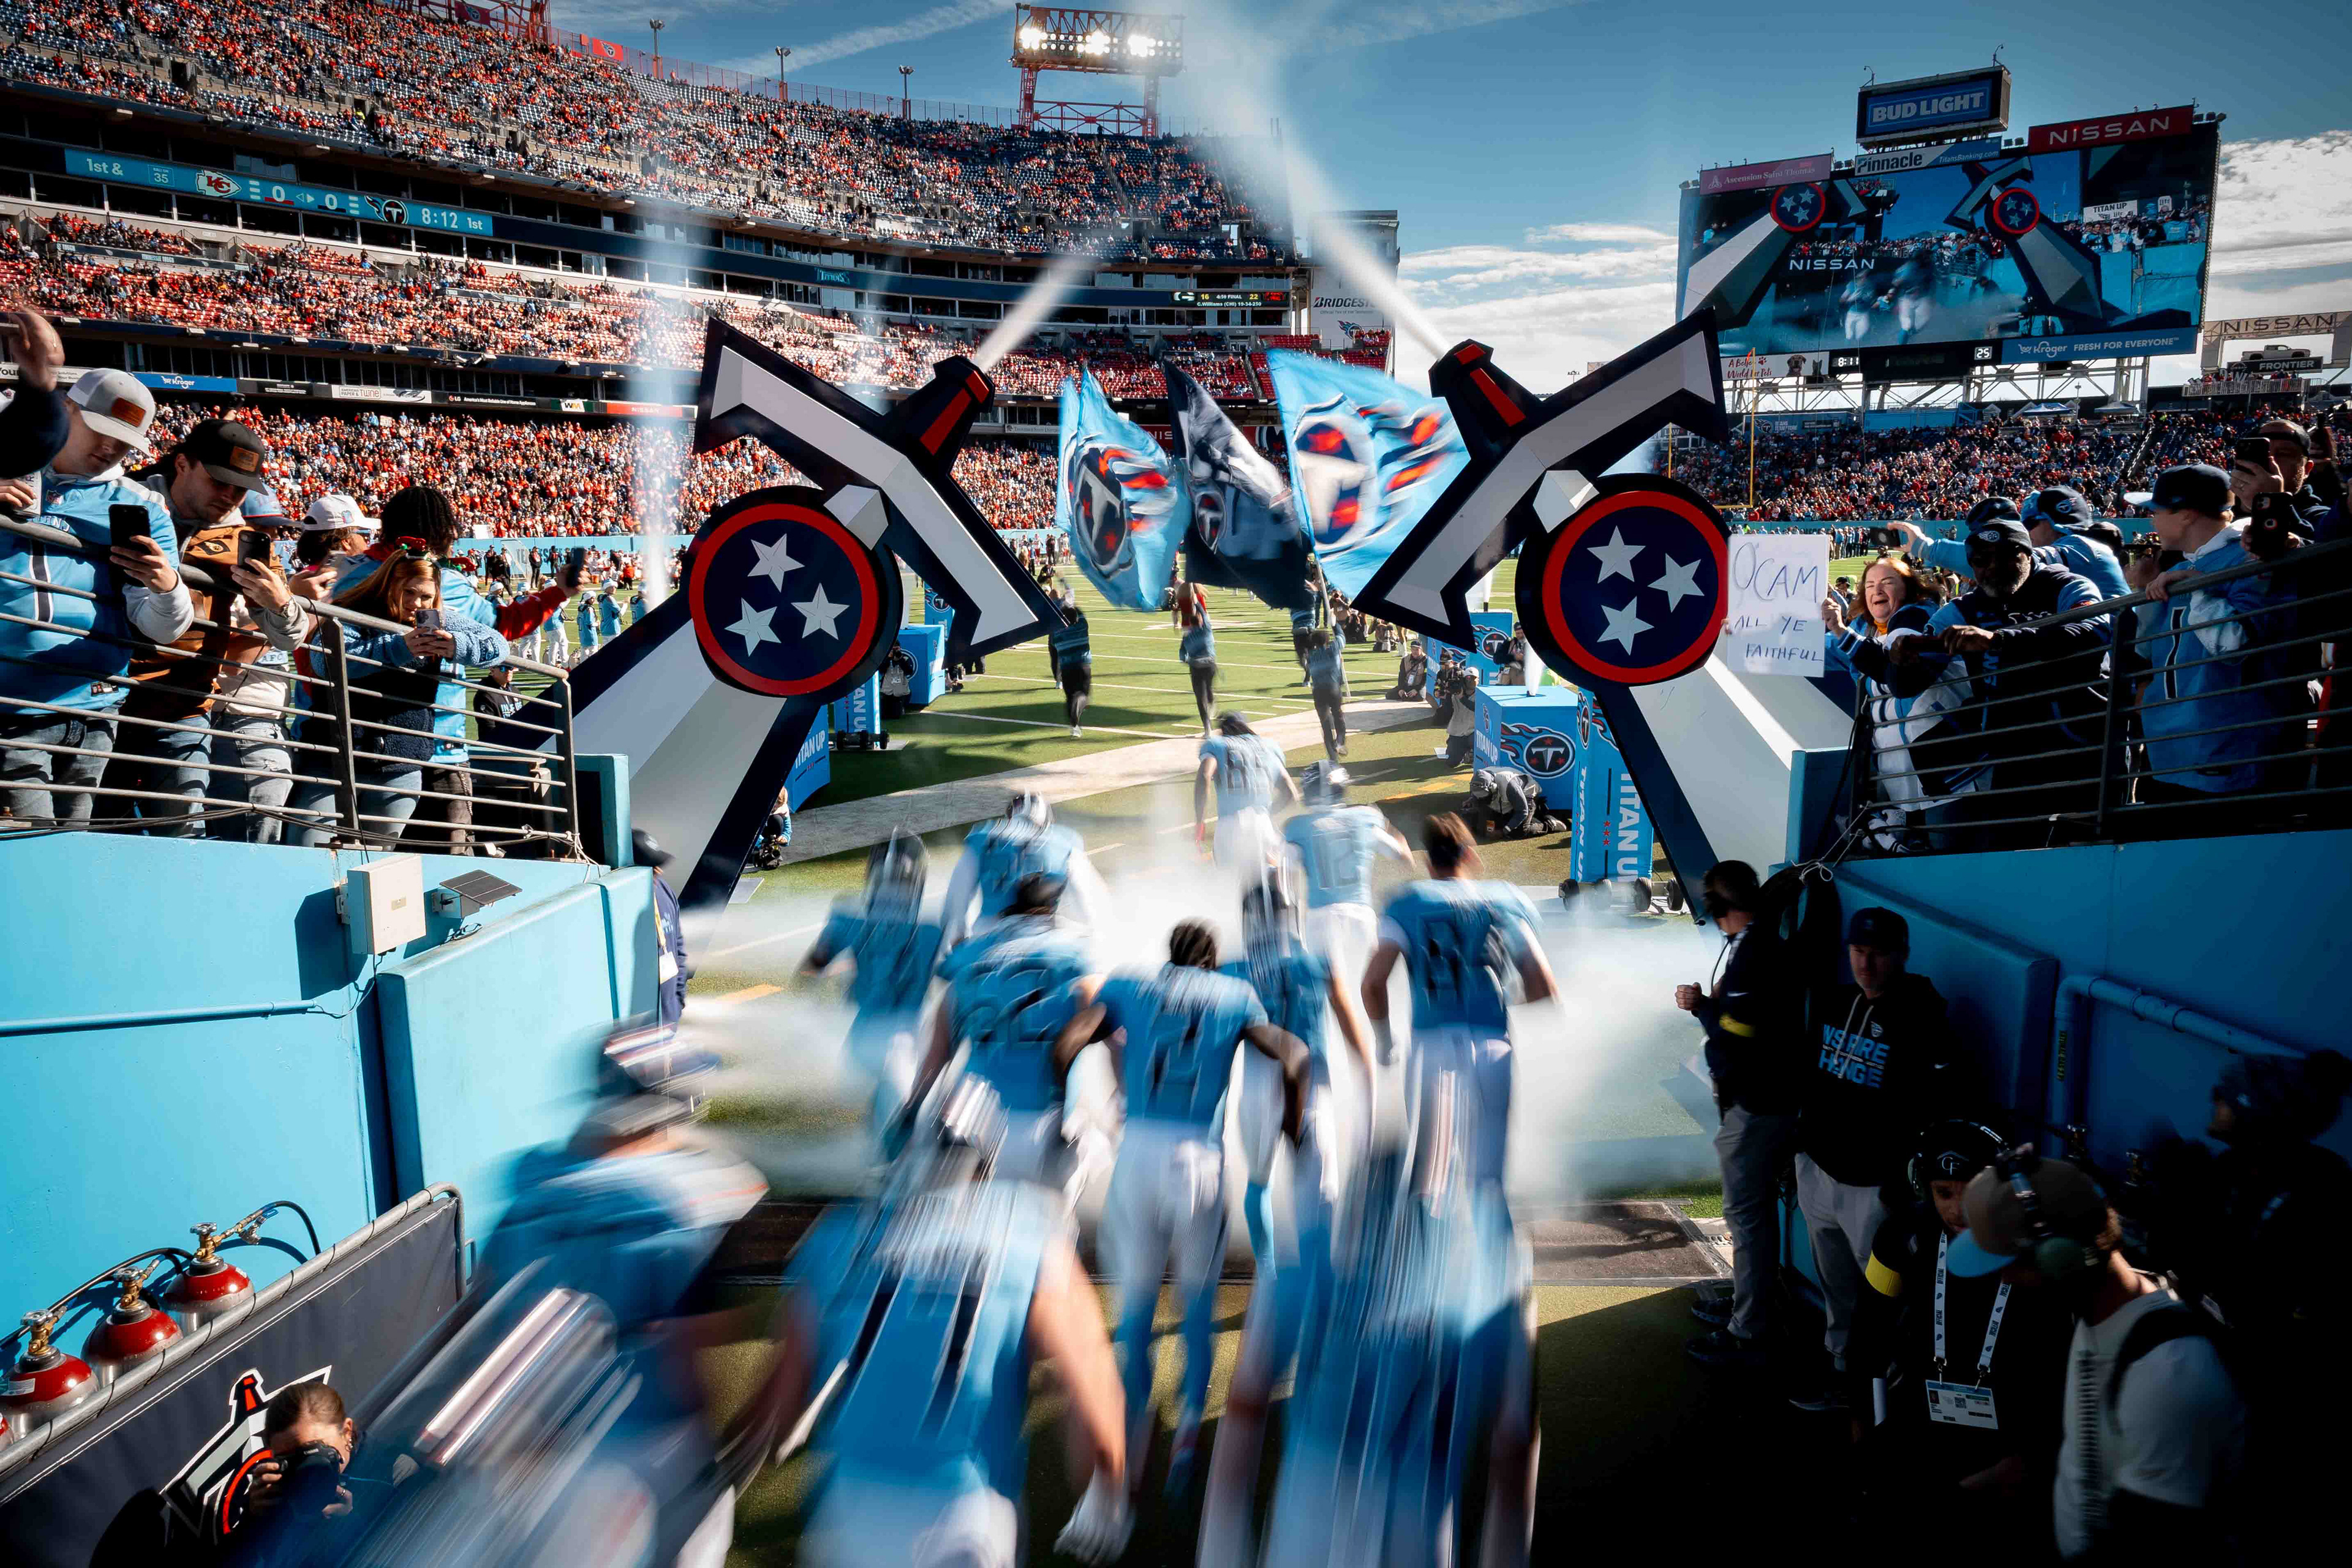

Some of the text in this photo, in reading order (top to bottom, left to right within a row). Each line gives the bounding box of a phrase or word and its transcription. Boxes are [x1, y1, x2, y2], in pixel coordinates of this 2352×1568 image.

[1872, 92, 1985, 123] BUD LIGHT
[2049, 116, 2169, 145] NISSAN
[1857, 153, 1923, 173] Pinnacle
[1939, 150, 1999, 164] TitansBanking.com
[86, 158, 123, 175] 1st &
[154, 172, 168, 183] 35
[1724, 167, 1815, 185] Ascension Saint Thomas
[271, 185, 285, 202] 0
[325, 194, 337, 209] 0
[2093, 204, 2115, 213] TITAN
[421, 208, 459, 229] 8:12
[467, 216, 483, 230] 1st
[1789, 258, 1875, 270] NISSAN
[2224, 314, 2334, 334] NISSAN
[1976, 347, 1990, 358] 25
[2033, 341, 2068, 358] Kroger
[2103, 341, 2123, 349] FOR
[1728, 359, 1735, 368] A
[1838, 357, 1859, 367] 8:11
[2259, 360, 2315, 371] FRONTIER
[1727, 369, 1748, 379] World
[1761, 368, 1772, 378] Pets
[172, 376, 195, 389] Kroger
[1734, 615, 1807, 635] ALL YE
[1746, 643, 1824, 662] FAITHFUL
[816, 729, 826, 752] UP
[1476, 729, 1498, 765] TITAN UP
[1579, 766, 1588, 847] TITAN
